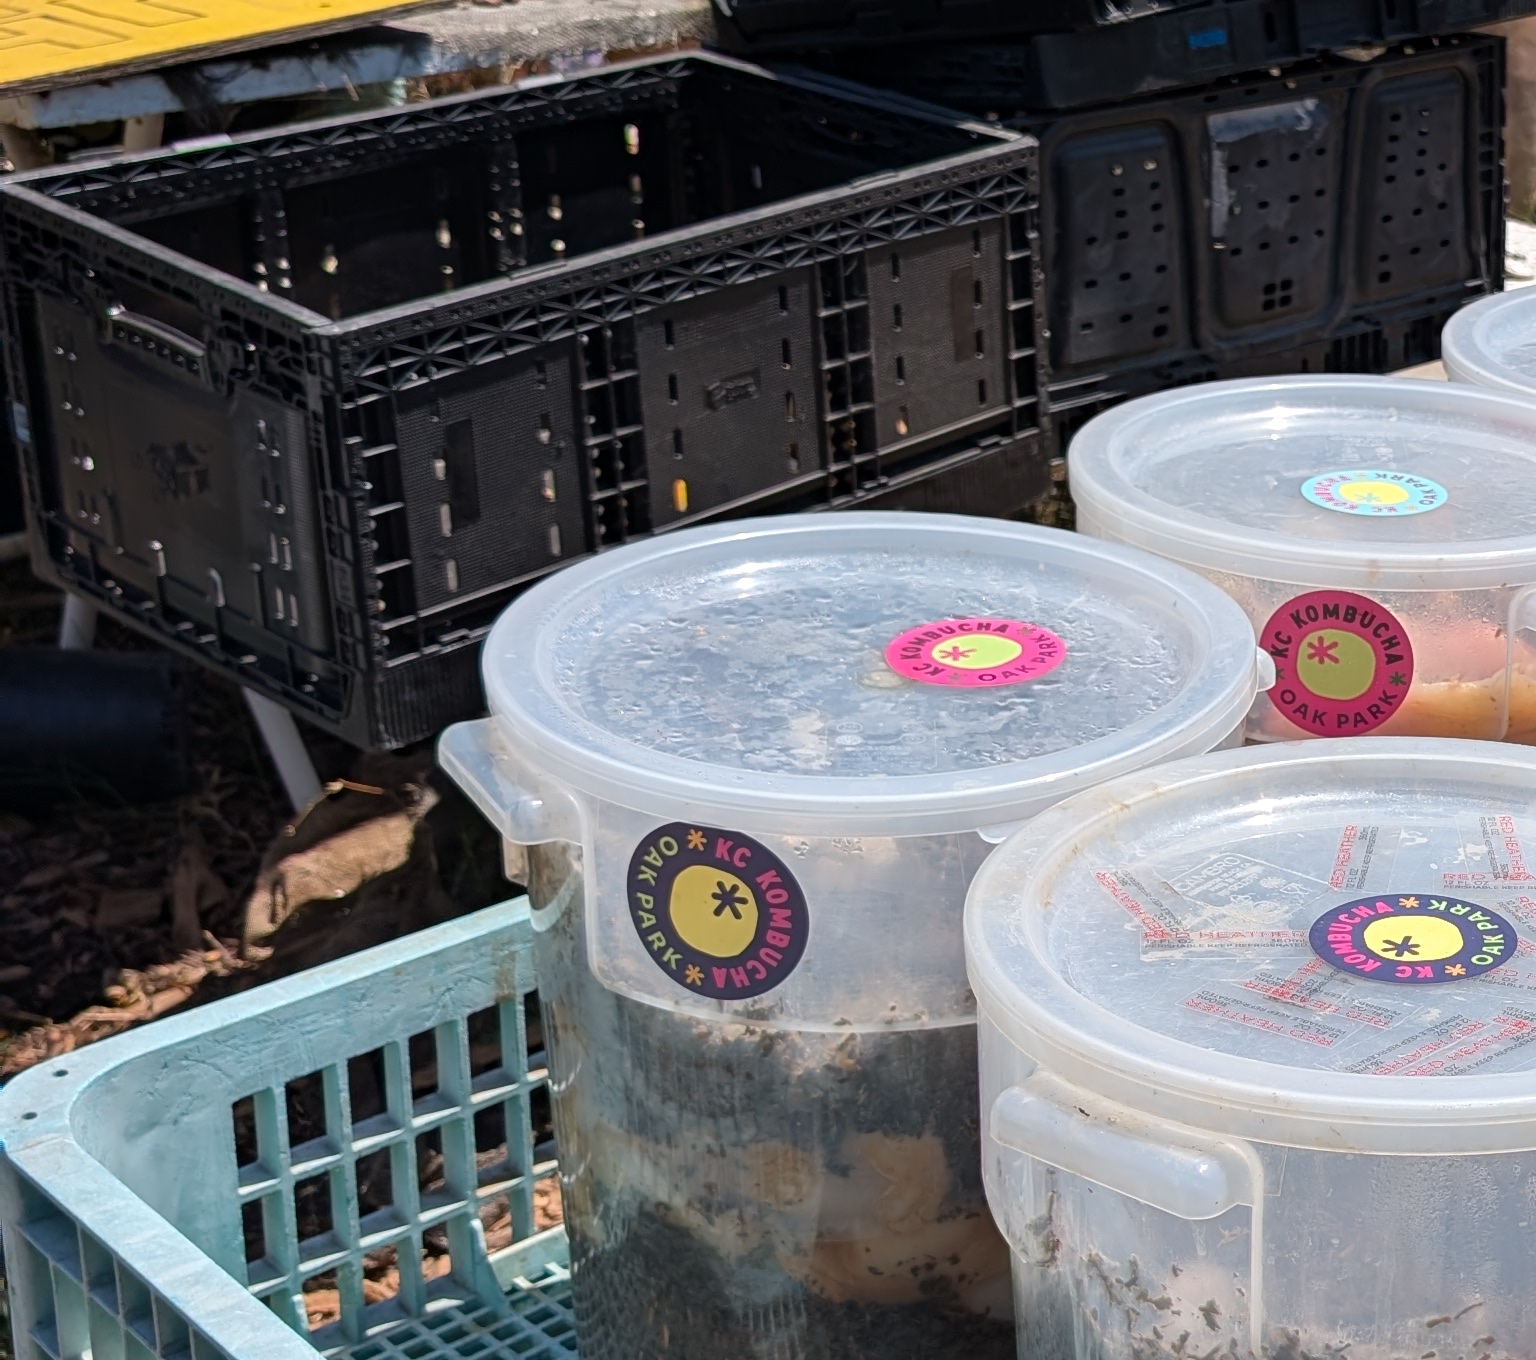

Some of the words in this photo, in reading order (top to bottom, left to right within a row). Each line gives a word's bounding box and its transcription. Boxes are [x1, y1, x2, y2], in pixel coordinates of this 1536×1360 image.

[1374, 472, 1429, 488] PARK
[1418, 489, 1438, 506] OAK
[900, 622, 1010, 660] KOMBUCHA
[1269, 630, 1292, 660] KC
[1289, 603, 1404, 665] KOMBUCHA
[912, 663, 946, 677] KC
[978, 665, 1038, 682] OAK
[1031, 633, 1058, 664] PARK
[1280, 689, 1328, 727] OAK
[1336, 689, 1398, 729] PARK
[1498, 816, 1515, 833] RED
[715, 837, 752, 868] KC
[1334, 825, 1357, 866] HEATHER
[637, 835, 679, 887] OAK
[1174, 856, 1241, 892] CAMBRO
[1329, 868, 1345, 888] RED
[1427, 899, 1500, 931] PARK
[636, 892, 683, 970] PARK
[711, 869, 793, 988] KOMBUCHA
[1327, 901, 1394, 973] KOMBUCHA
[1470, 933, 1505, 965] OAK
[1394, 965, 1435, 979] KC
[1489, 966, 1520, 977] ED
[1184, 998, 1285, 1031] HEATHER
[1293, 1022, 1311, 1030] OZ
[1343, 1009, 1390, 1028] RED
[1286, 1027, 1335, 1047] RED
[1312, 1027, 1327, 1035] FL
[1431, 1027, 1450, 1036] OZ
[1443, 1021, 1487, 1040] RED
[1442, 1063, 1460, 1072] OZ
